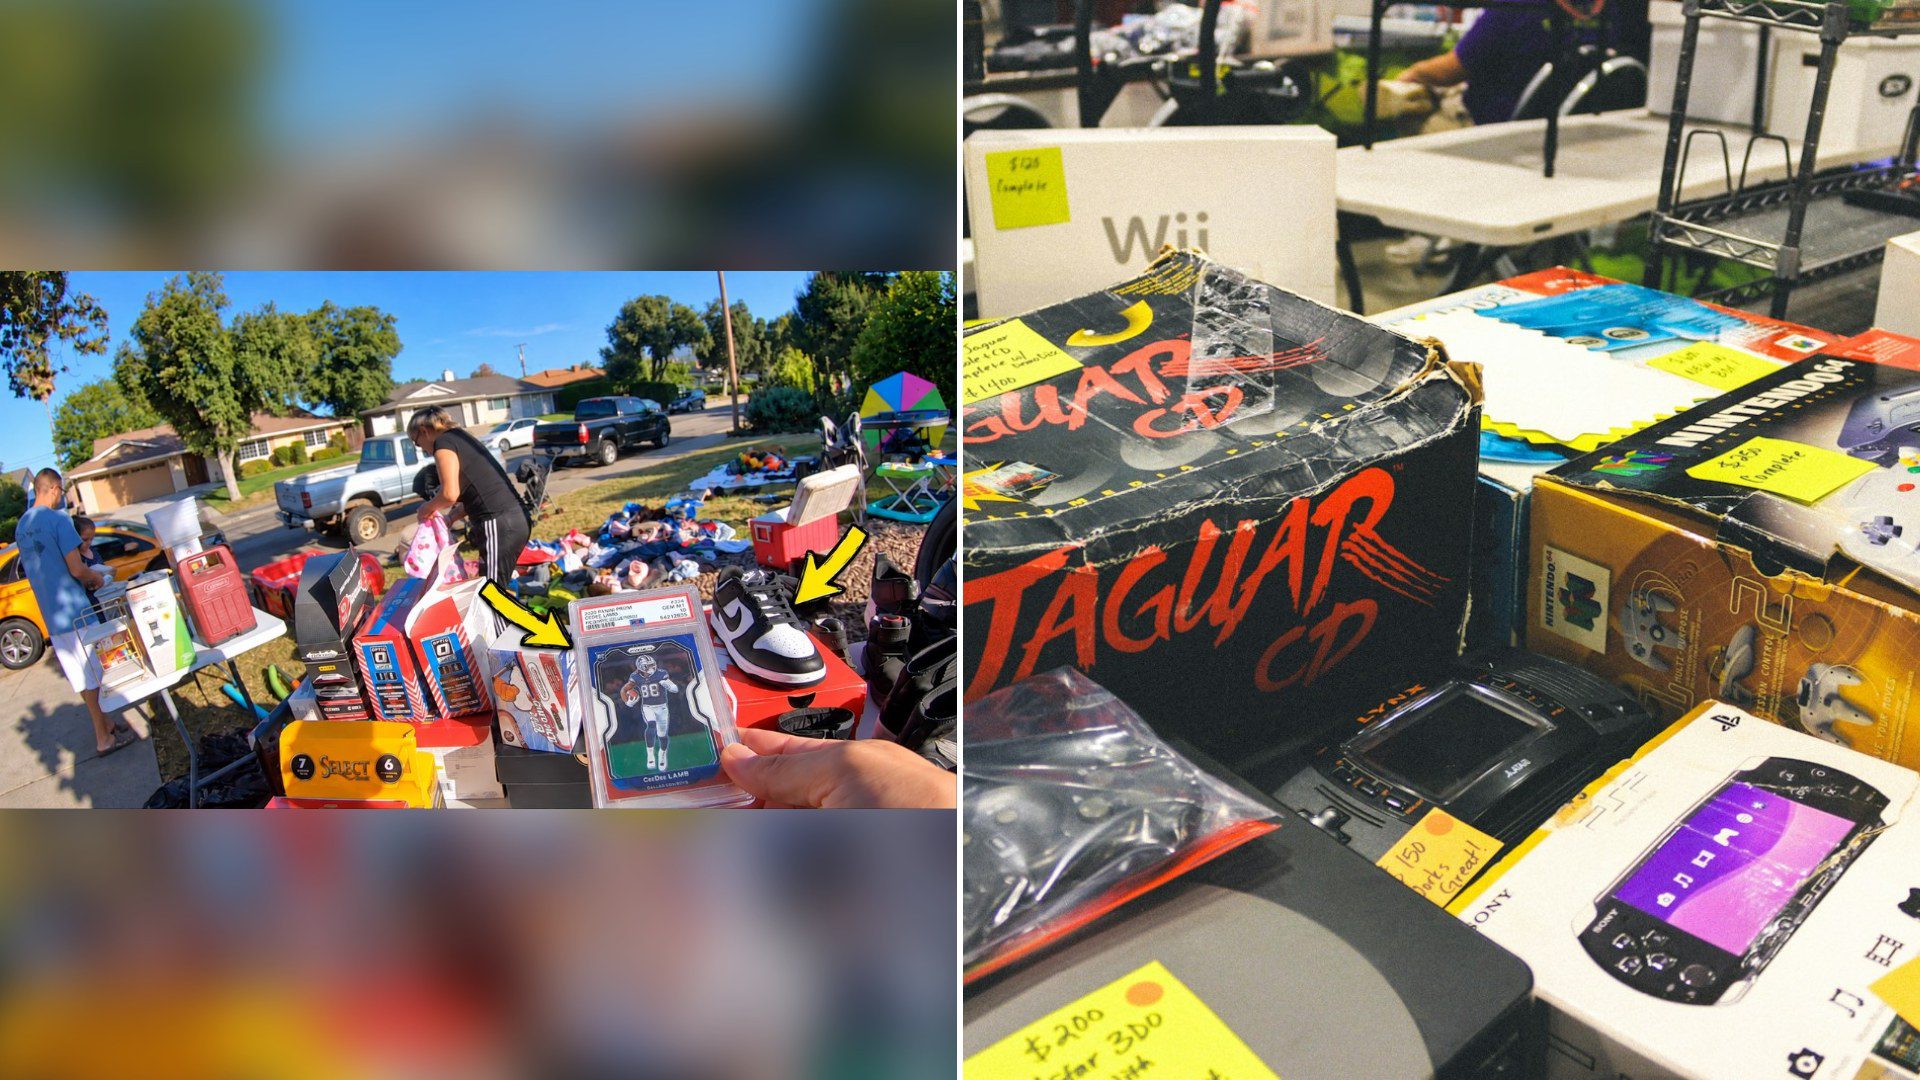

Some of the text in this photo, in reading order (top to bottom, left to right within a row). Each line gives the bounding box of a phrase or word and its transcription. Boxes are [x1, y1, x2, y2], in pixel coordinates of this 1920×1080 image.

[1102, 212, 1209, 265] Wii
[1133, 385, 1244, 438] CD
[1740, 450, 1806, 484] Complete
[1254, 599, 1379, 693] CD
[1758, 632, 1776, 676] CONTROL
[641, 683, 660, 698] 88
[1355, 683, 1428, 724] LYNX
[298, 758, 306, 769] 7
[319, 755, 371, 779] SELECT
[384, 758, 394, 771] 6
[667, 770, 690, 780] LAMB
[1440, 839, 1488, 895] Great!
[1592, 907, 1619, 934] SONY
[1024, 1008, 1105, 1062] $200
[1107, 1012, 1163, 1055] 3DO
